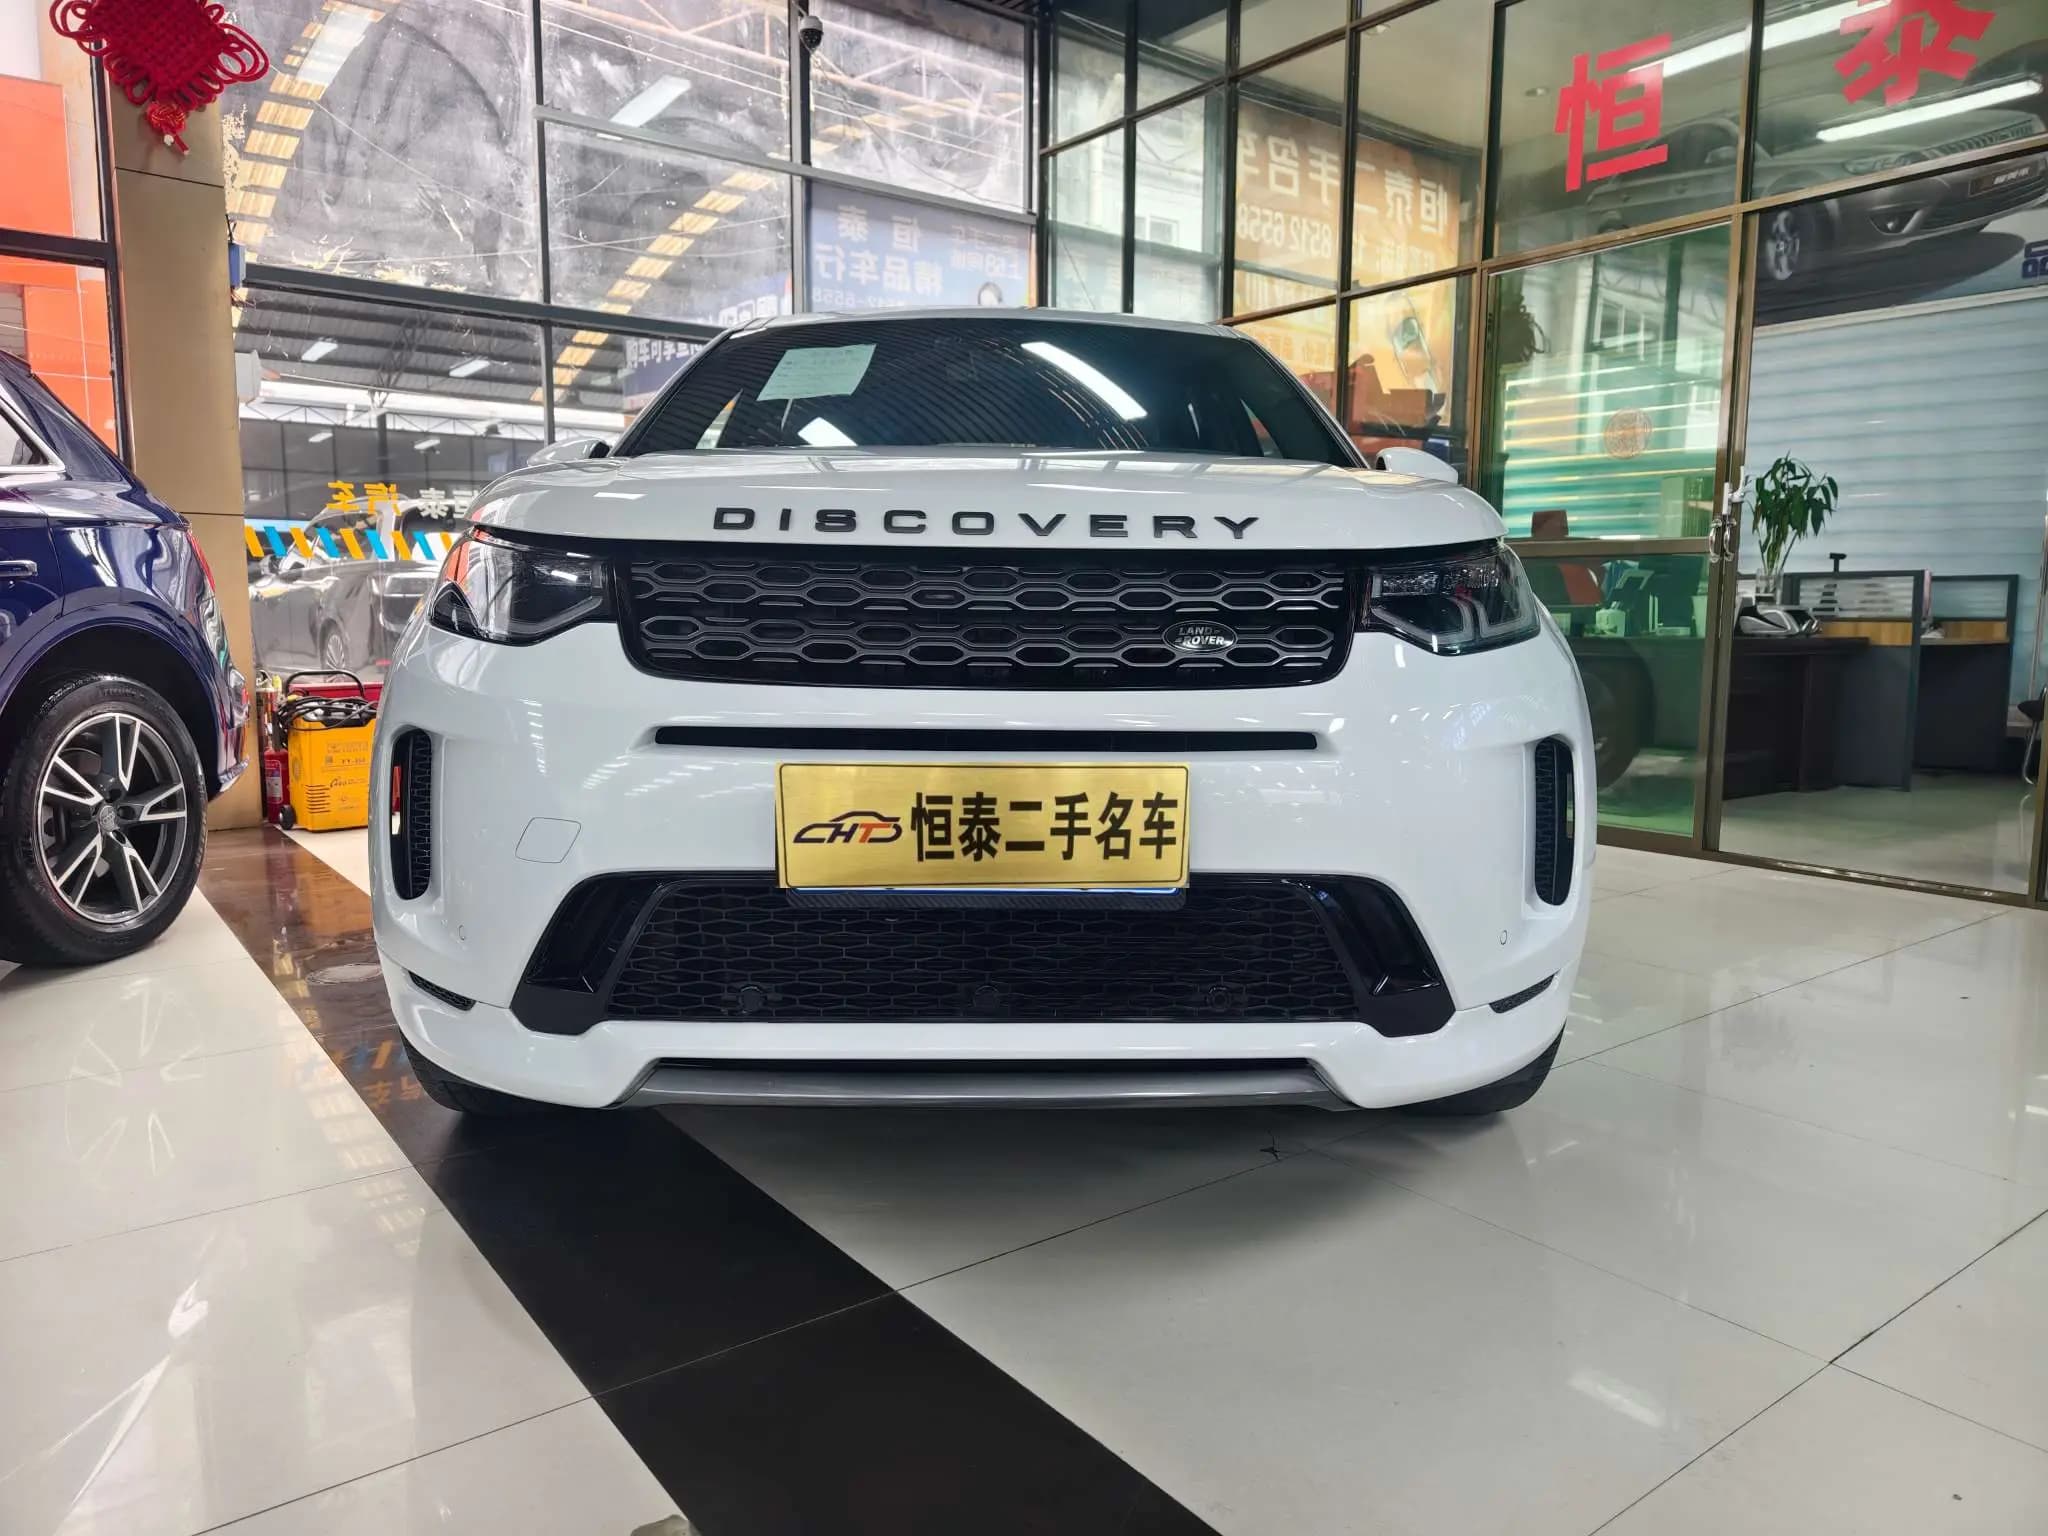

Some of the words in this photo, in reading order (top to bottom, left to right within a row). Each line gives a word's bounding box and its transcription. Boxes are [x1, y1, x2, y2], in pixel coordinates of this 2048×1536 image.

[1555, 32, 1672, 192] 恒
[712, 506, 1260, 540] DISCOVERY
[1178, 626, 1213, 636] LAND
[1181, 635, 1225, 646] ROVER
[910, 790, 1178, 863] 恒泰二手名车
